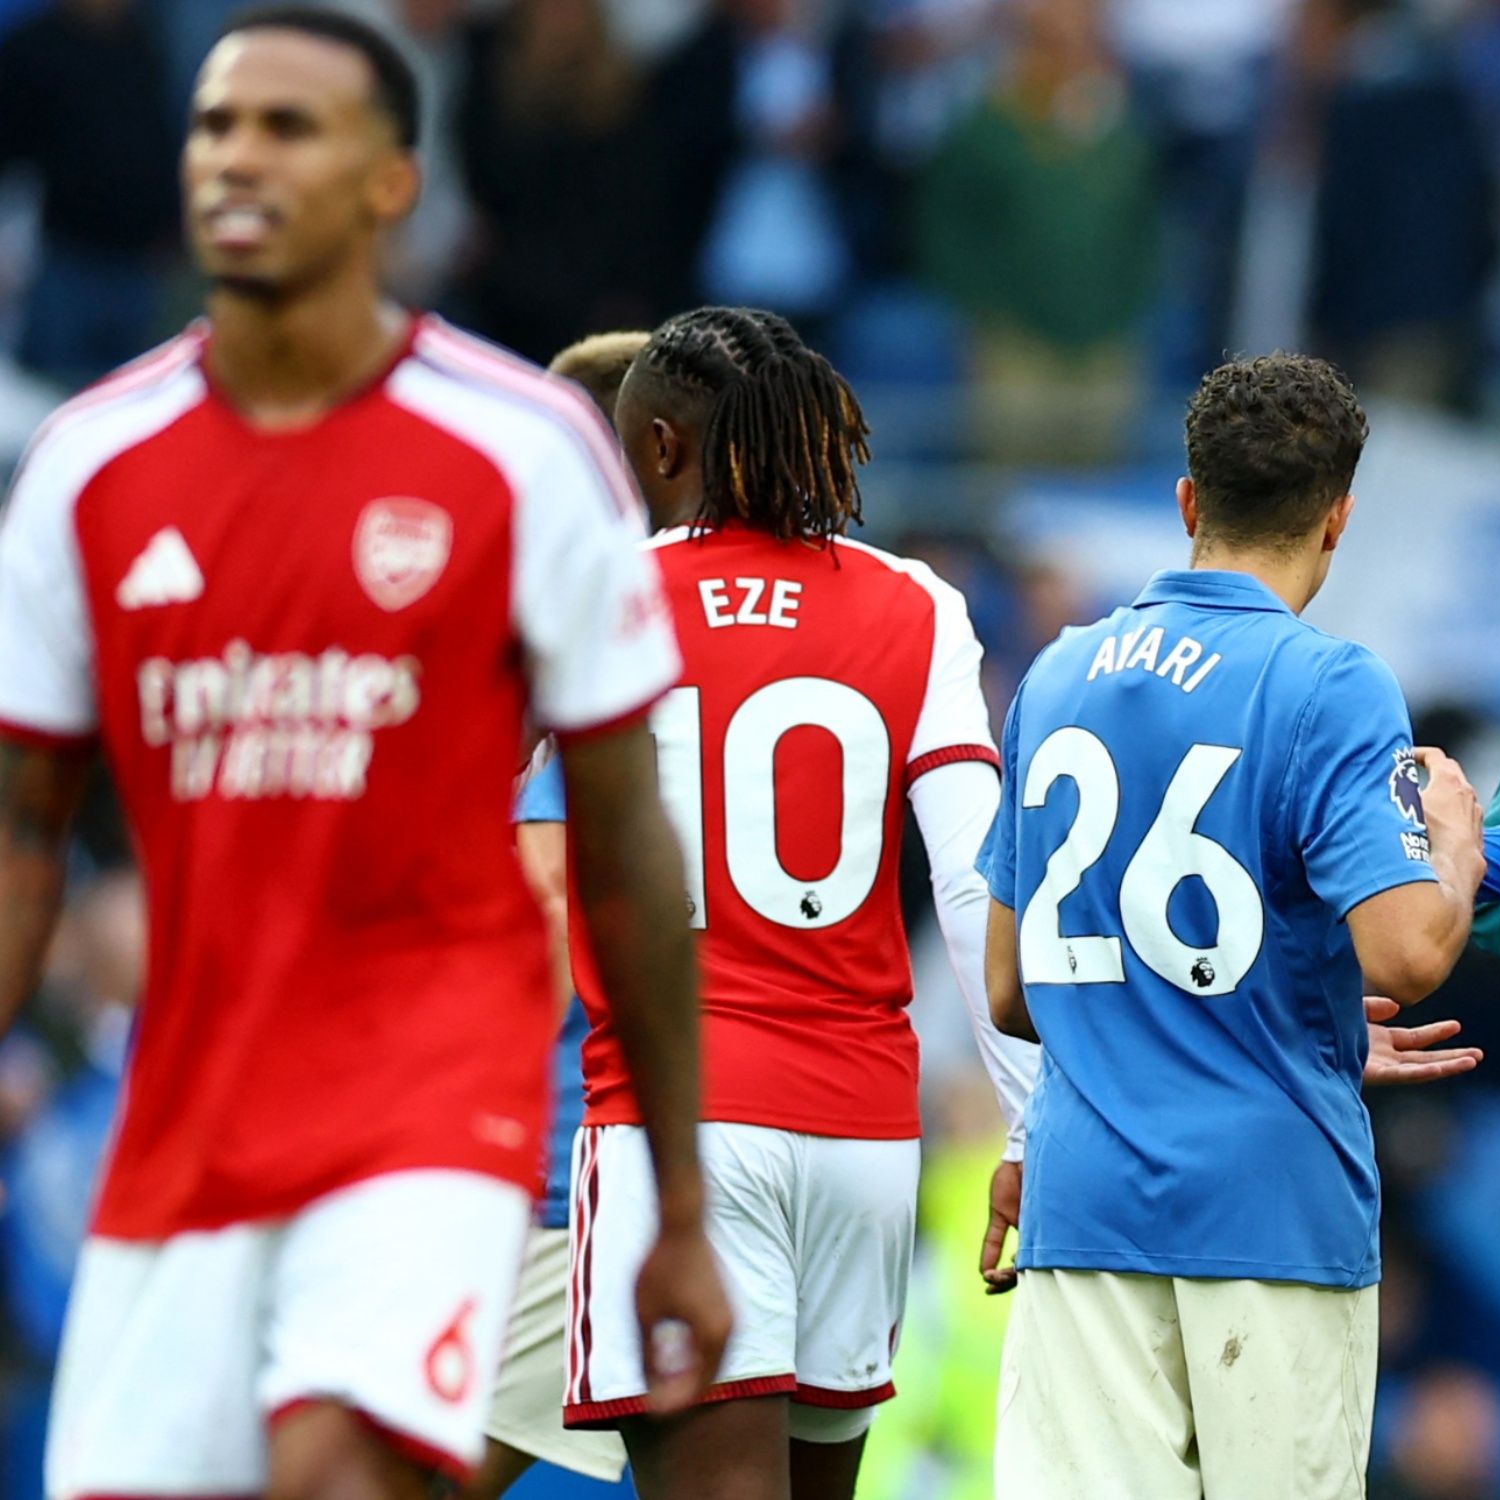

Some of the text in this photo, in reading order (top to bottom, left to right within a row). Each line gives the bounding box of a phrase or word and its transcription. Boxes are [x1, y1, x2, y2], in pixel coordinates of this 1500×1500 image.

[698, 577, 802, 628] EZE
[1087, 627, 1221, 692] AYARI
[648, 676, 890, 930] 10
[1020, 726, 1264, 996] 26
[422, 1296, 478, 1405] 6
